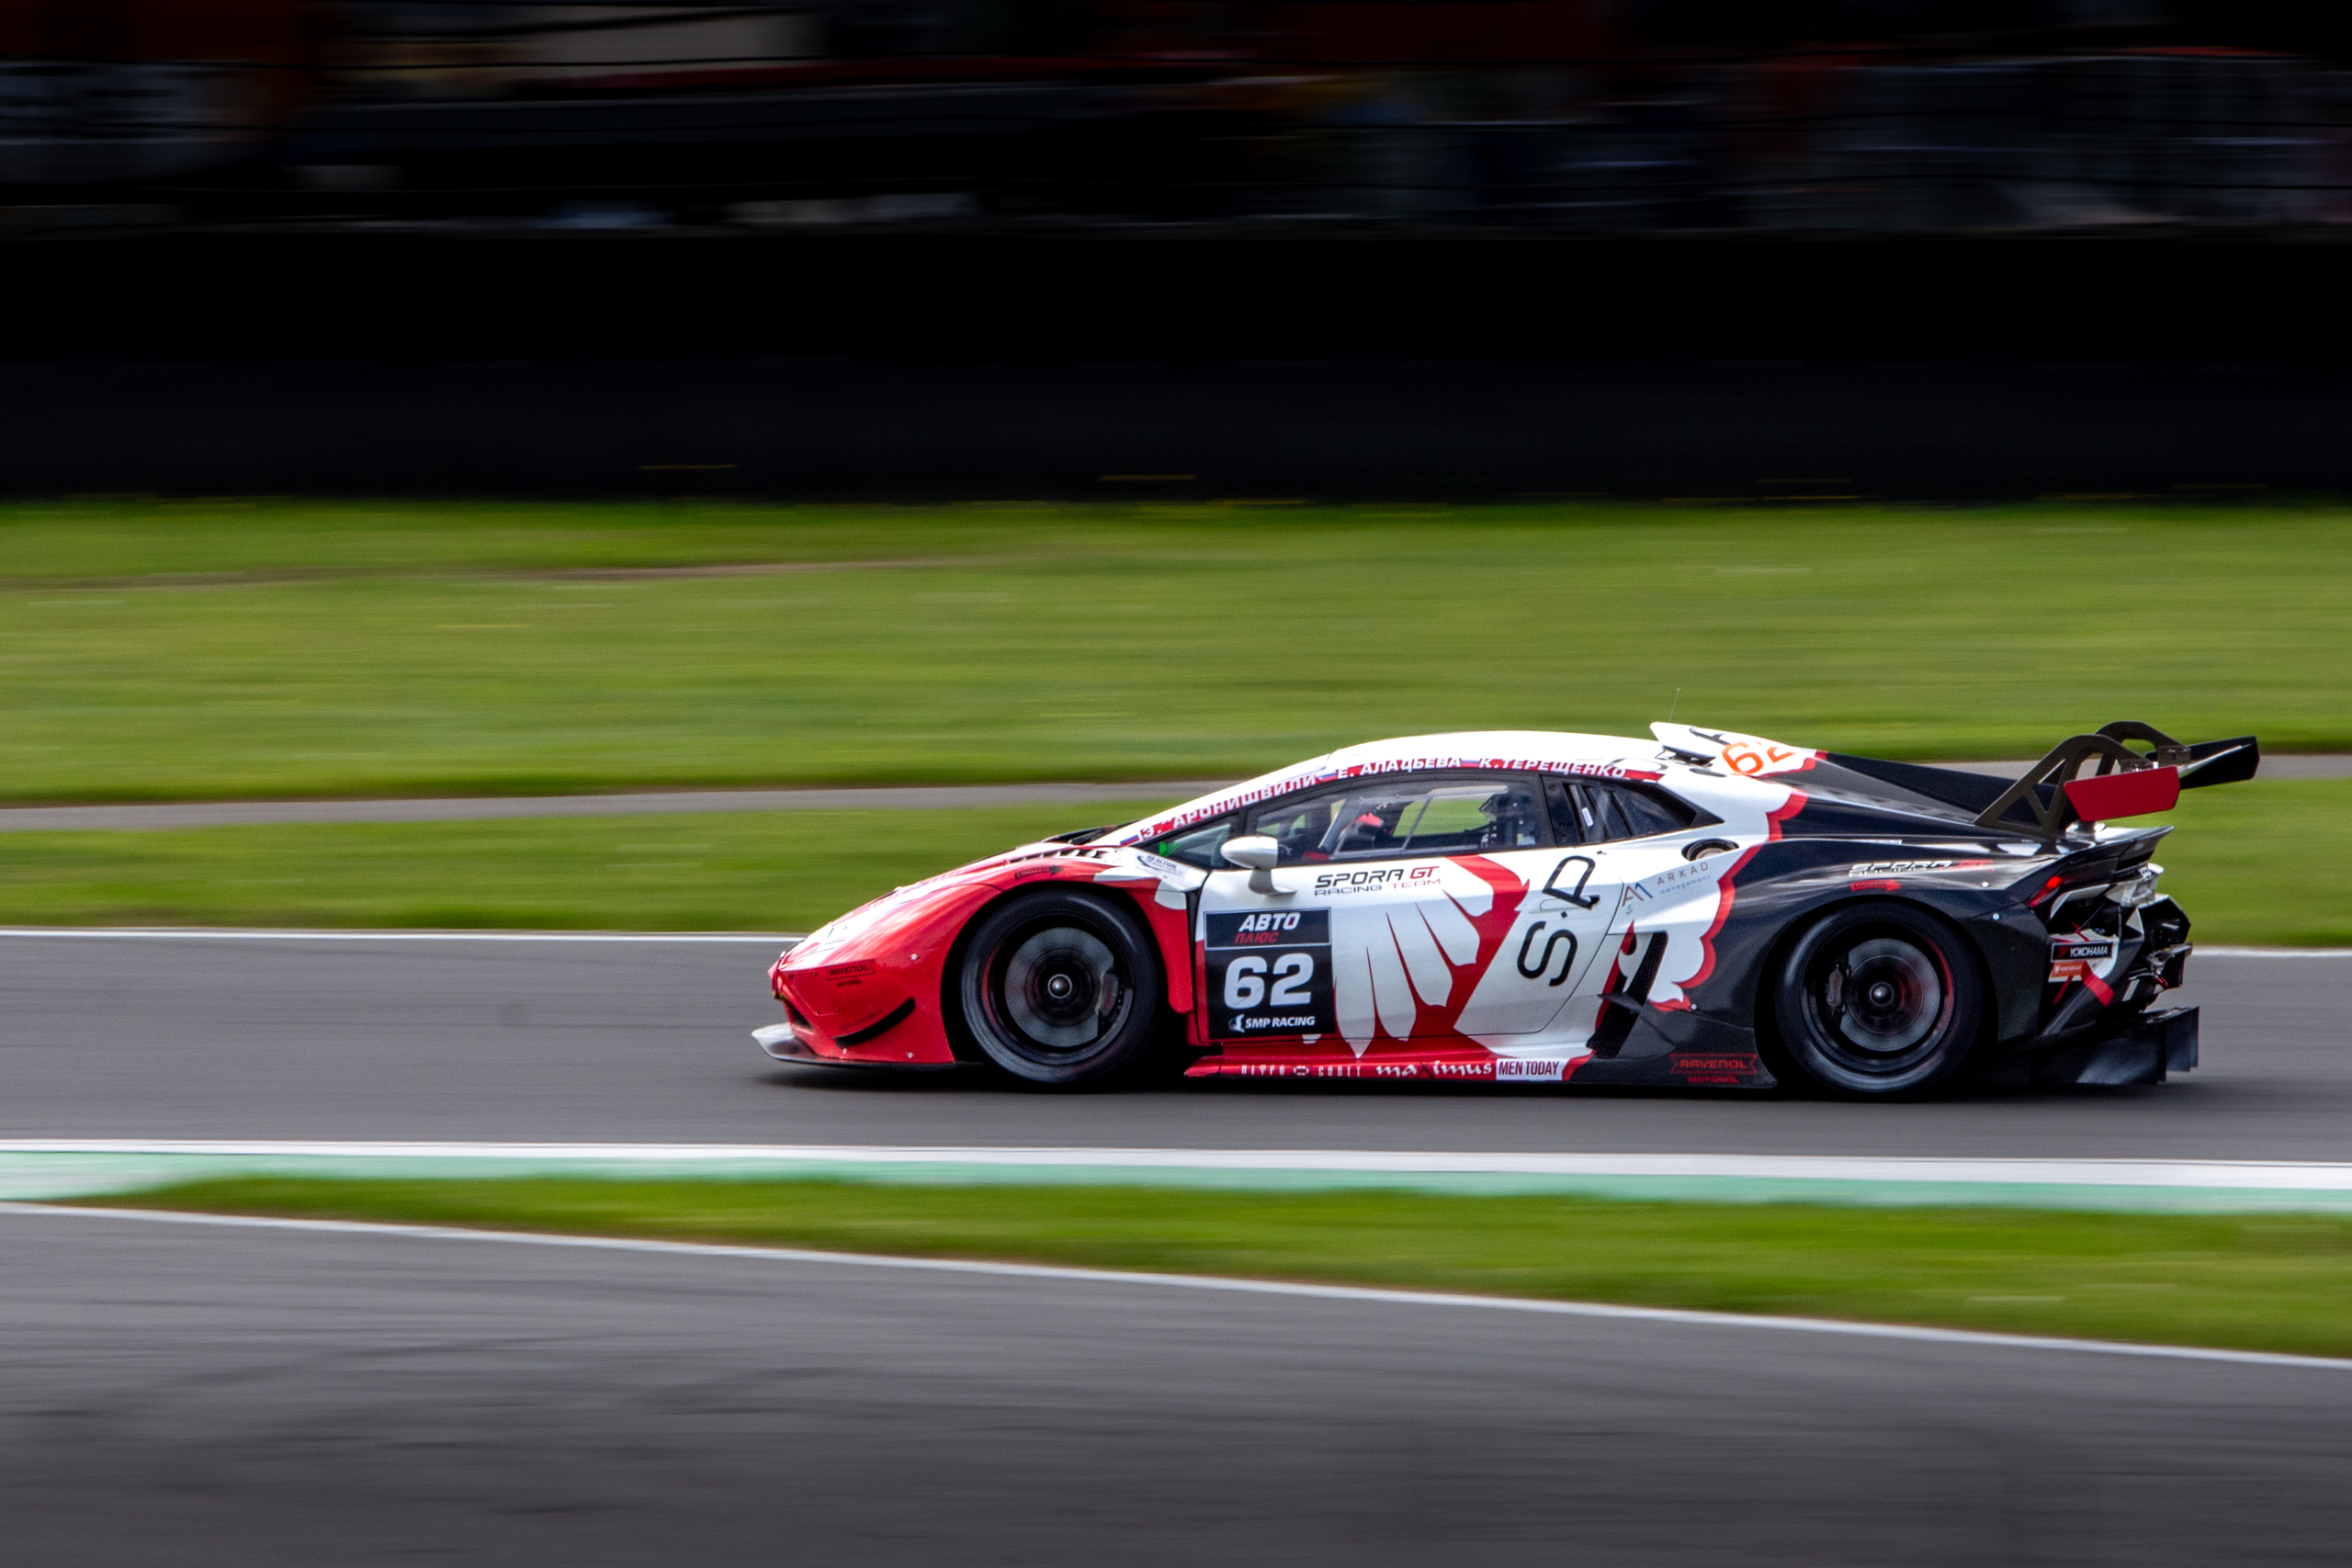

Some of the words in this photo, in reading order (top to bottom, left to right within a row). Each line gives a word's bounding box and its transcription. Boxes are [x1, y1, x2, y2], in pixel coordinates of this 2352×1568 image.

[1172, 774, 1317, 829] АРОНИШВИЛИ
[1315, 869, 1404, 888] SPORA
[1410, 866, 1440, 879] GT
[1657, 862, 1709, 886] ARKAD
[1315, 885, 1382, 897] RACING
[1389, 879, 1441, 889] TEAM
[1238, 912, 1301, 932] АВТО
[1234, 931, 1279, 944] ПЛЮС
[2070, 945, 2108, 957] YOKOHAMA
[830, 964, 870, 976] RAVENOL
[1224, 953, 1314, 1010] 62
[1245, 1018, 1271, 1029] SMP
[1272, 1016, 1316, 1028] RACING
[1498, 1061, 1522, 1075] MEN
[1525, 1061, 1560, 1075] TODAY
[1679, 1059, 1747, 1069] RAVENOL
